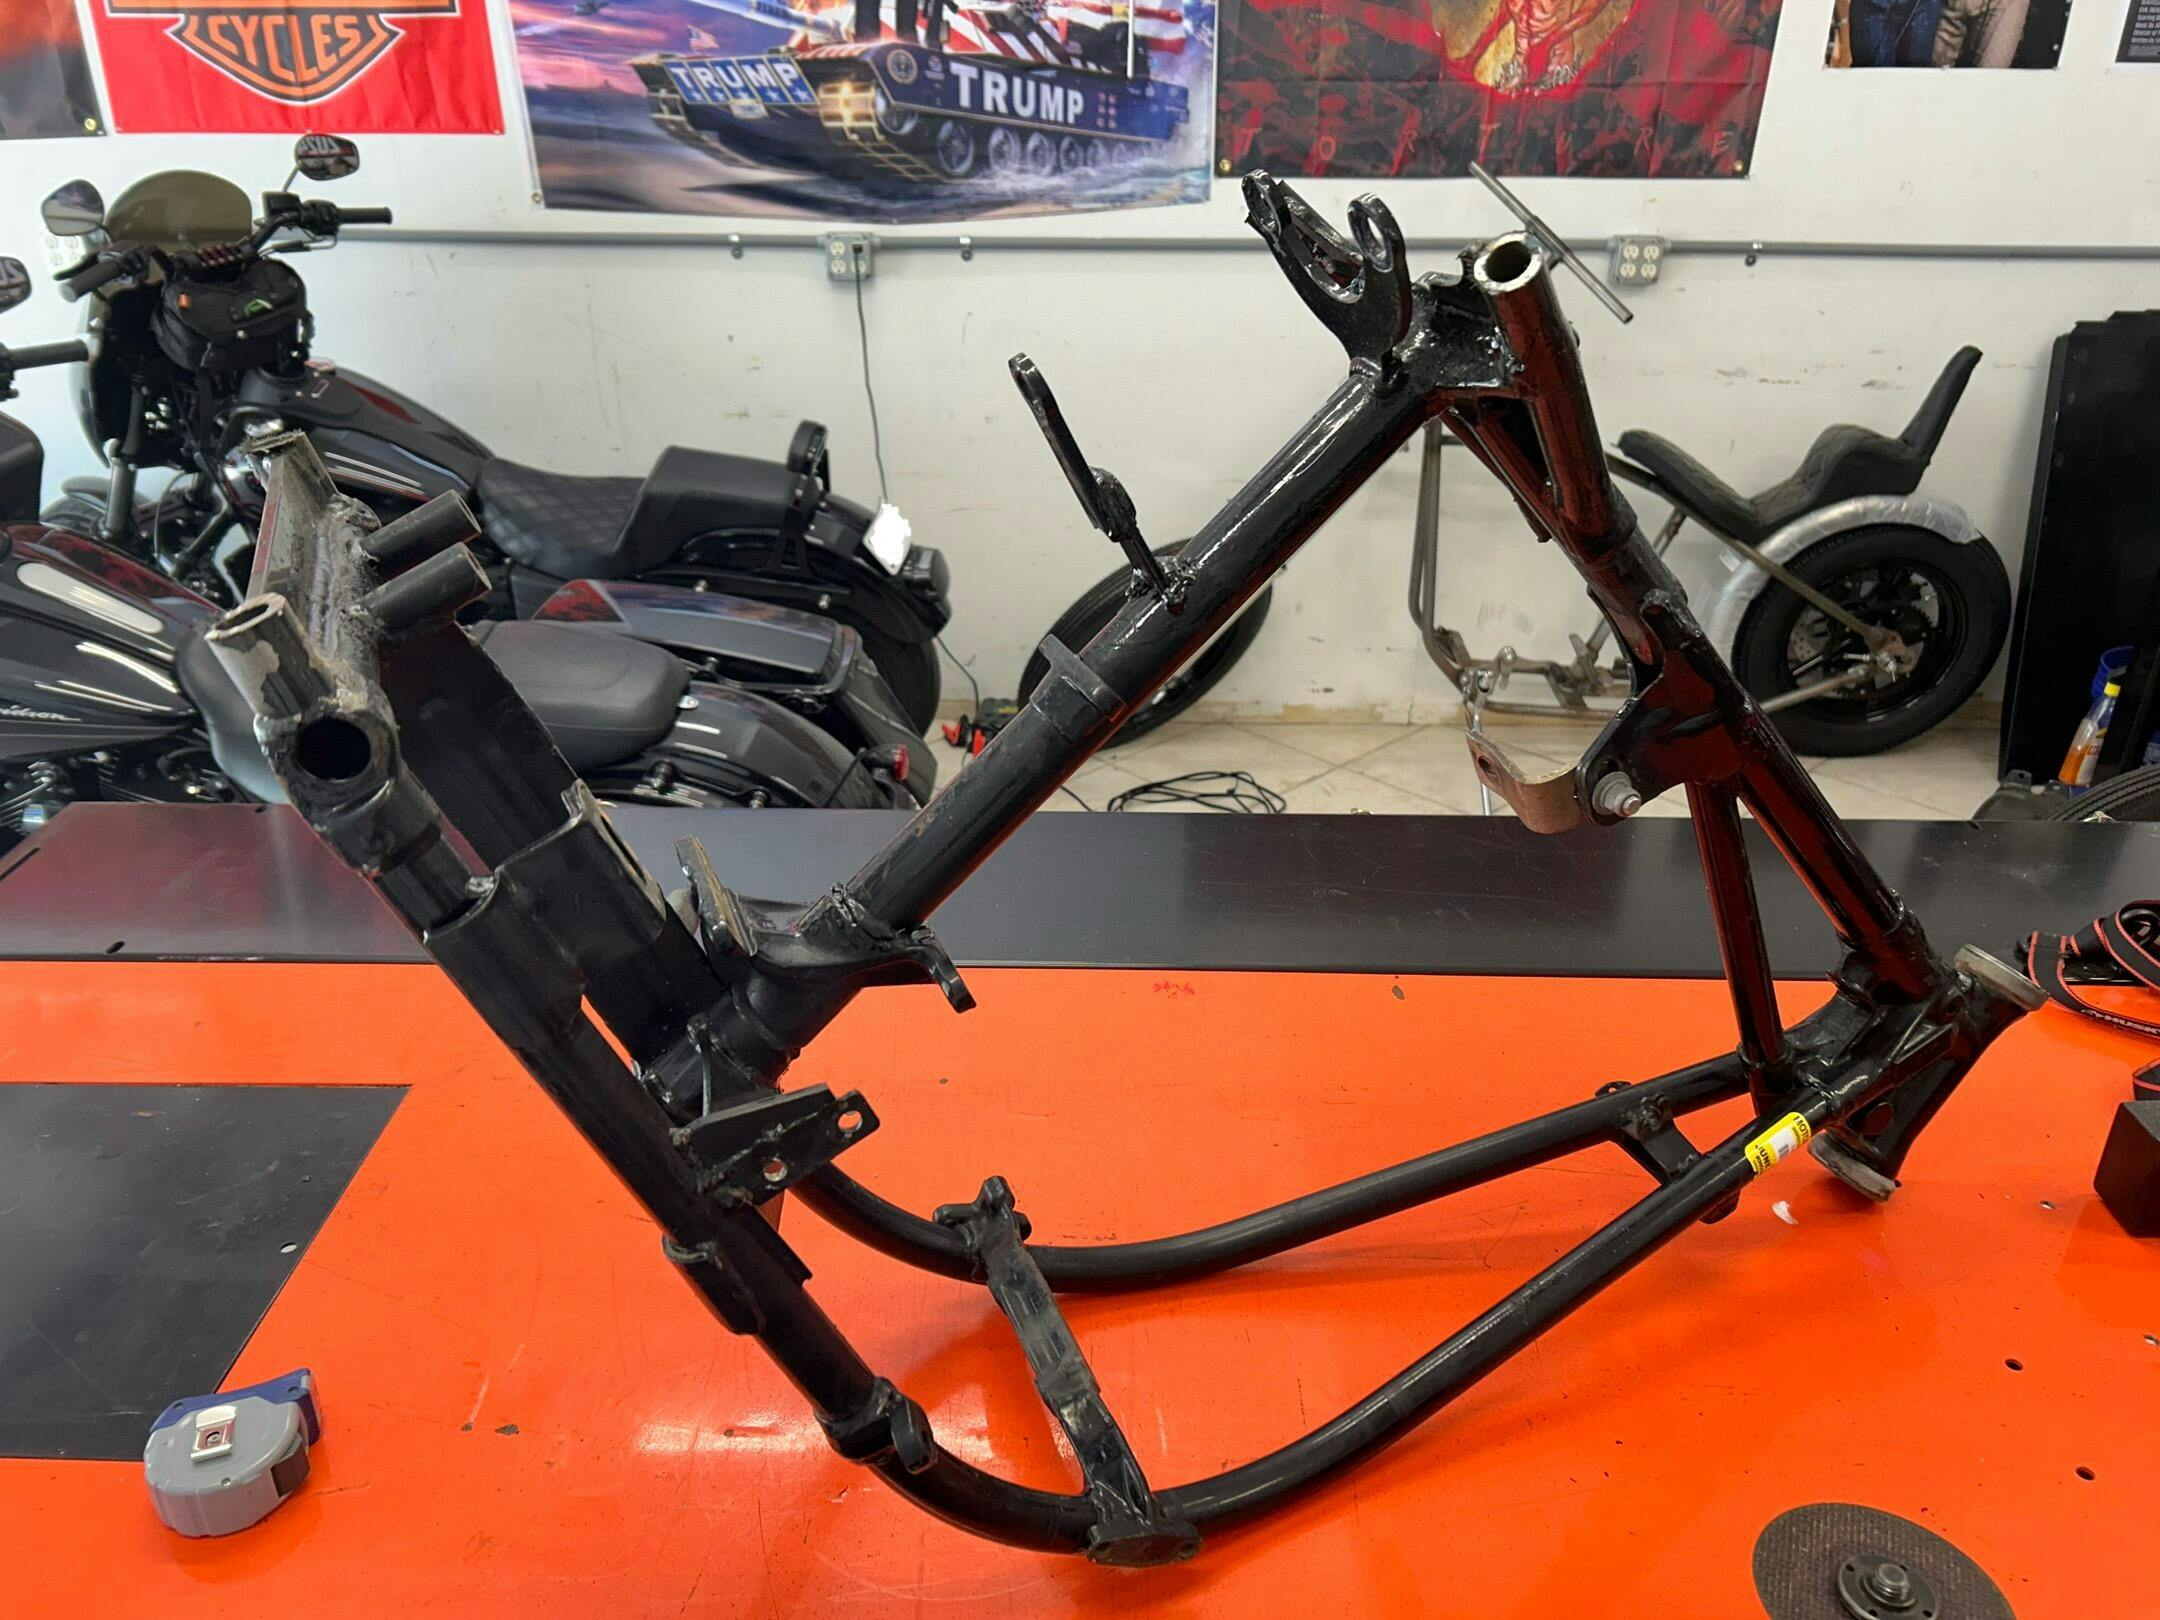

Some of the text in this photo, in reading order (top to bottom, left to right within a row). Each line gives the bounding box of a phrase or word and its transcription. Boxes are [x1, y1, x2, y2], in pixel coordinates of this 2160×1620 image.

[207, 15, 361, 82] CYCLES
[669, 63, 799, 88] TRUMP
[950, 61, 1085, 124] TRUMP
